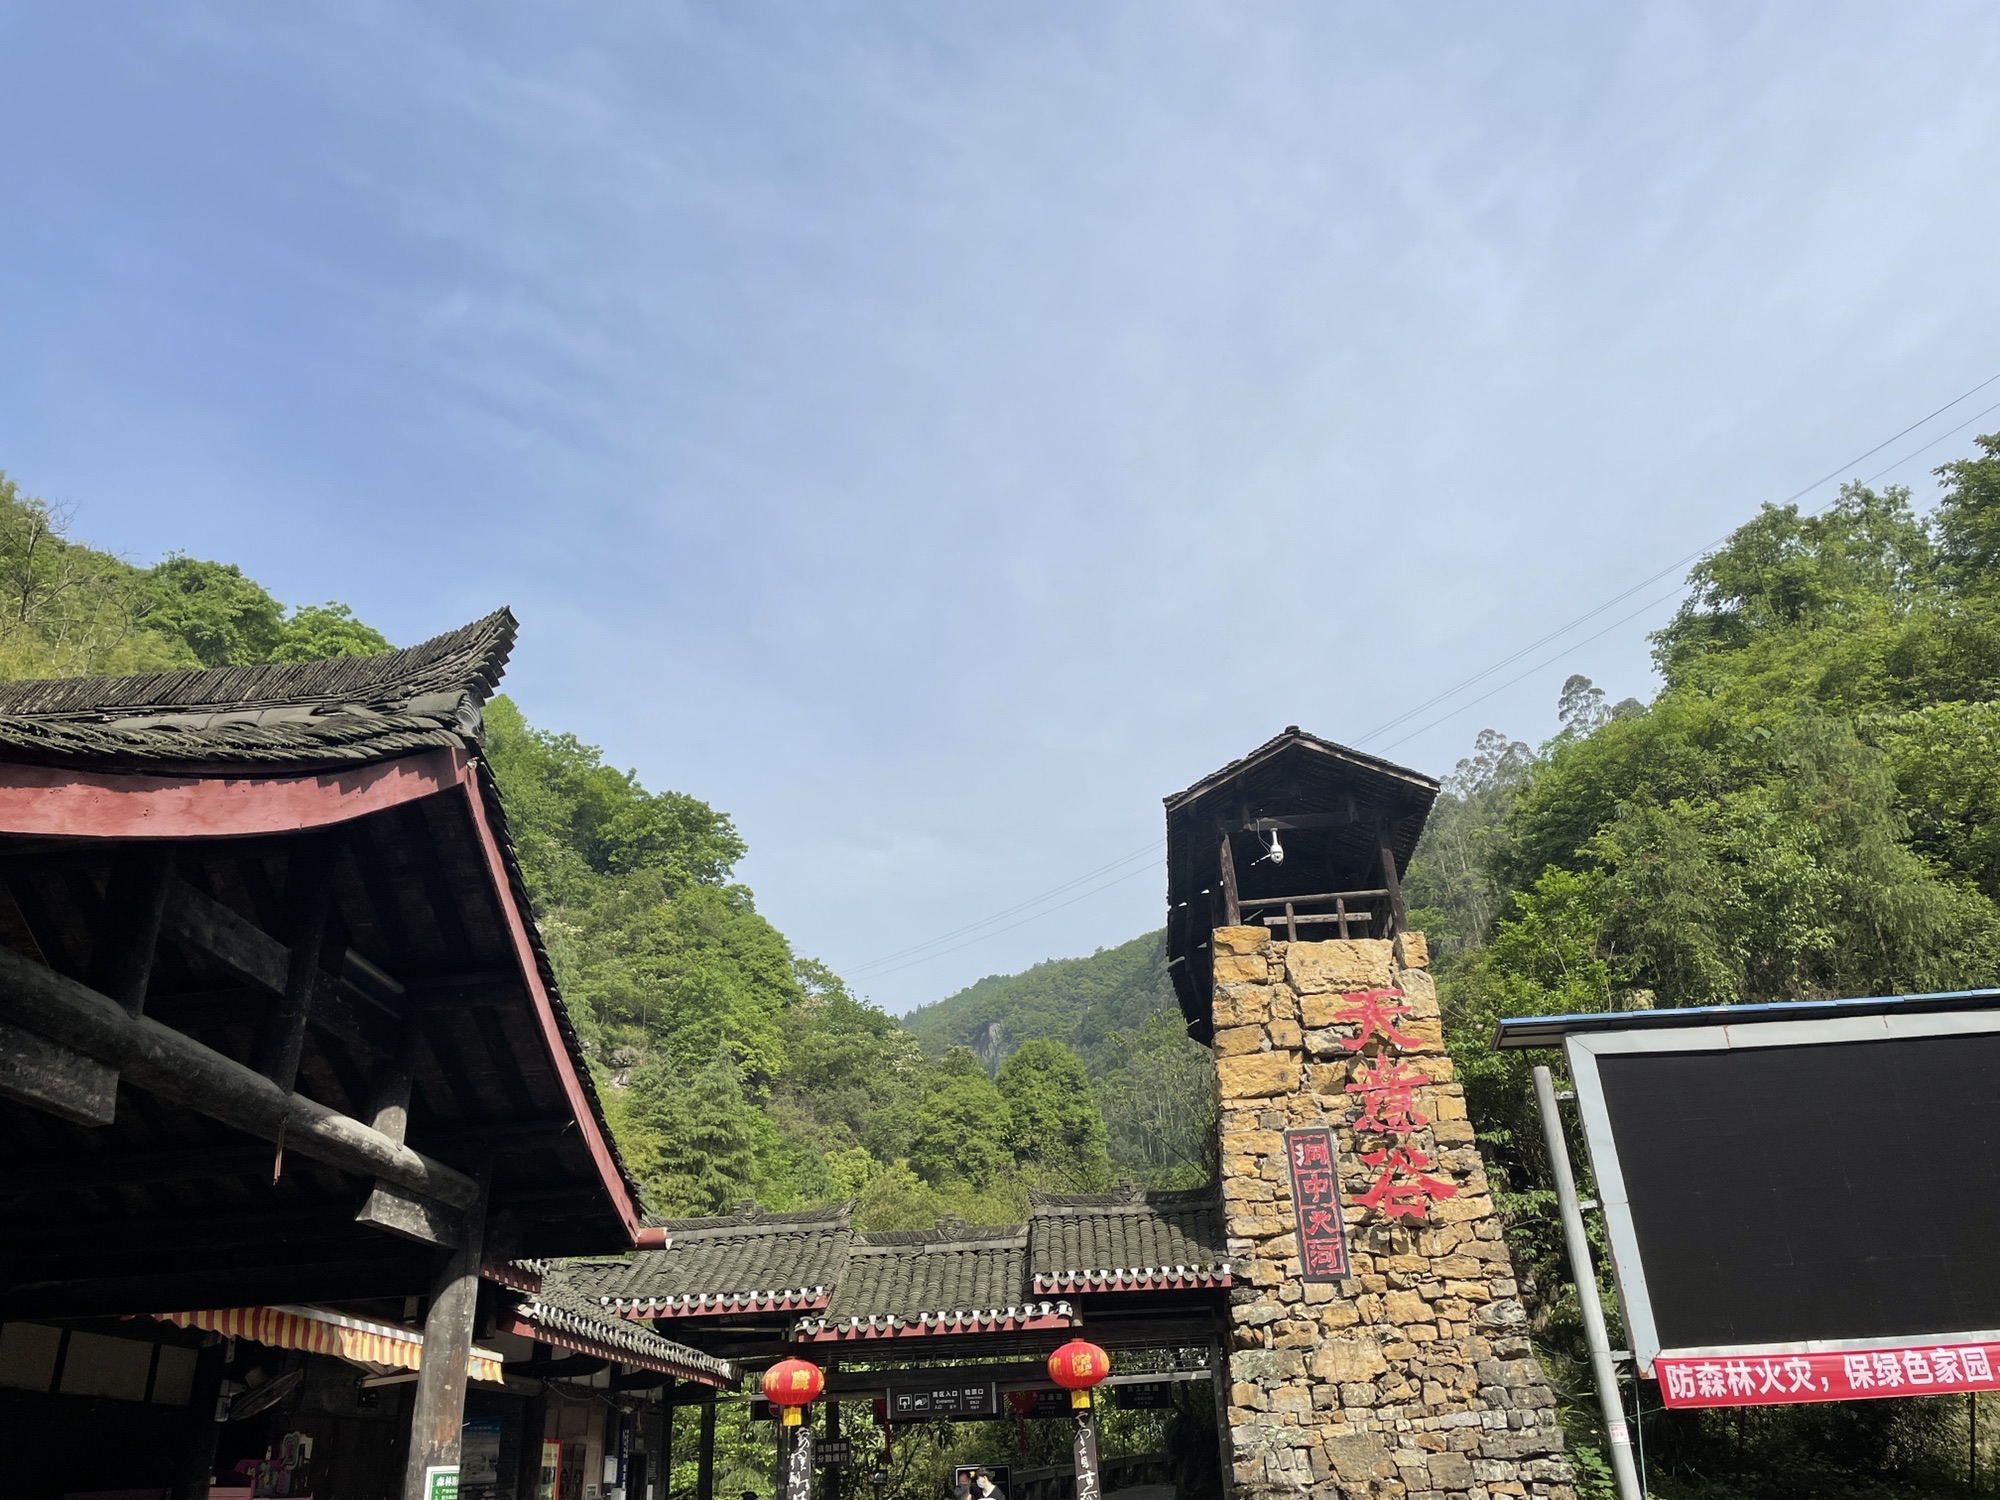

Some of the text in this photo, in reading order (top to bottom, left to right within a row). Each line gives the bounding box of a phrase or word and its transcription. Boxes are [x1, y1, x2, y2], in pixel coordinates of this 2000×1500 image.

[1295, 1143, 1338, 1268] 洞中天河
[1665, 1346, 2000, 1399] 防森林火灾，保绿色家园
